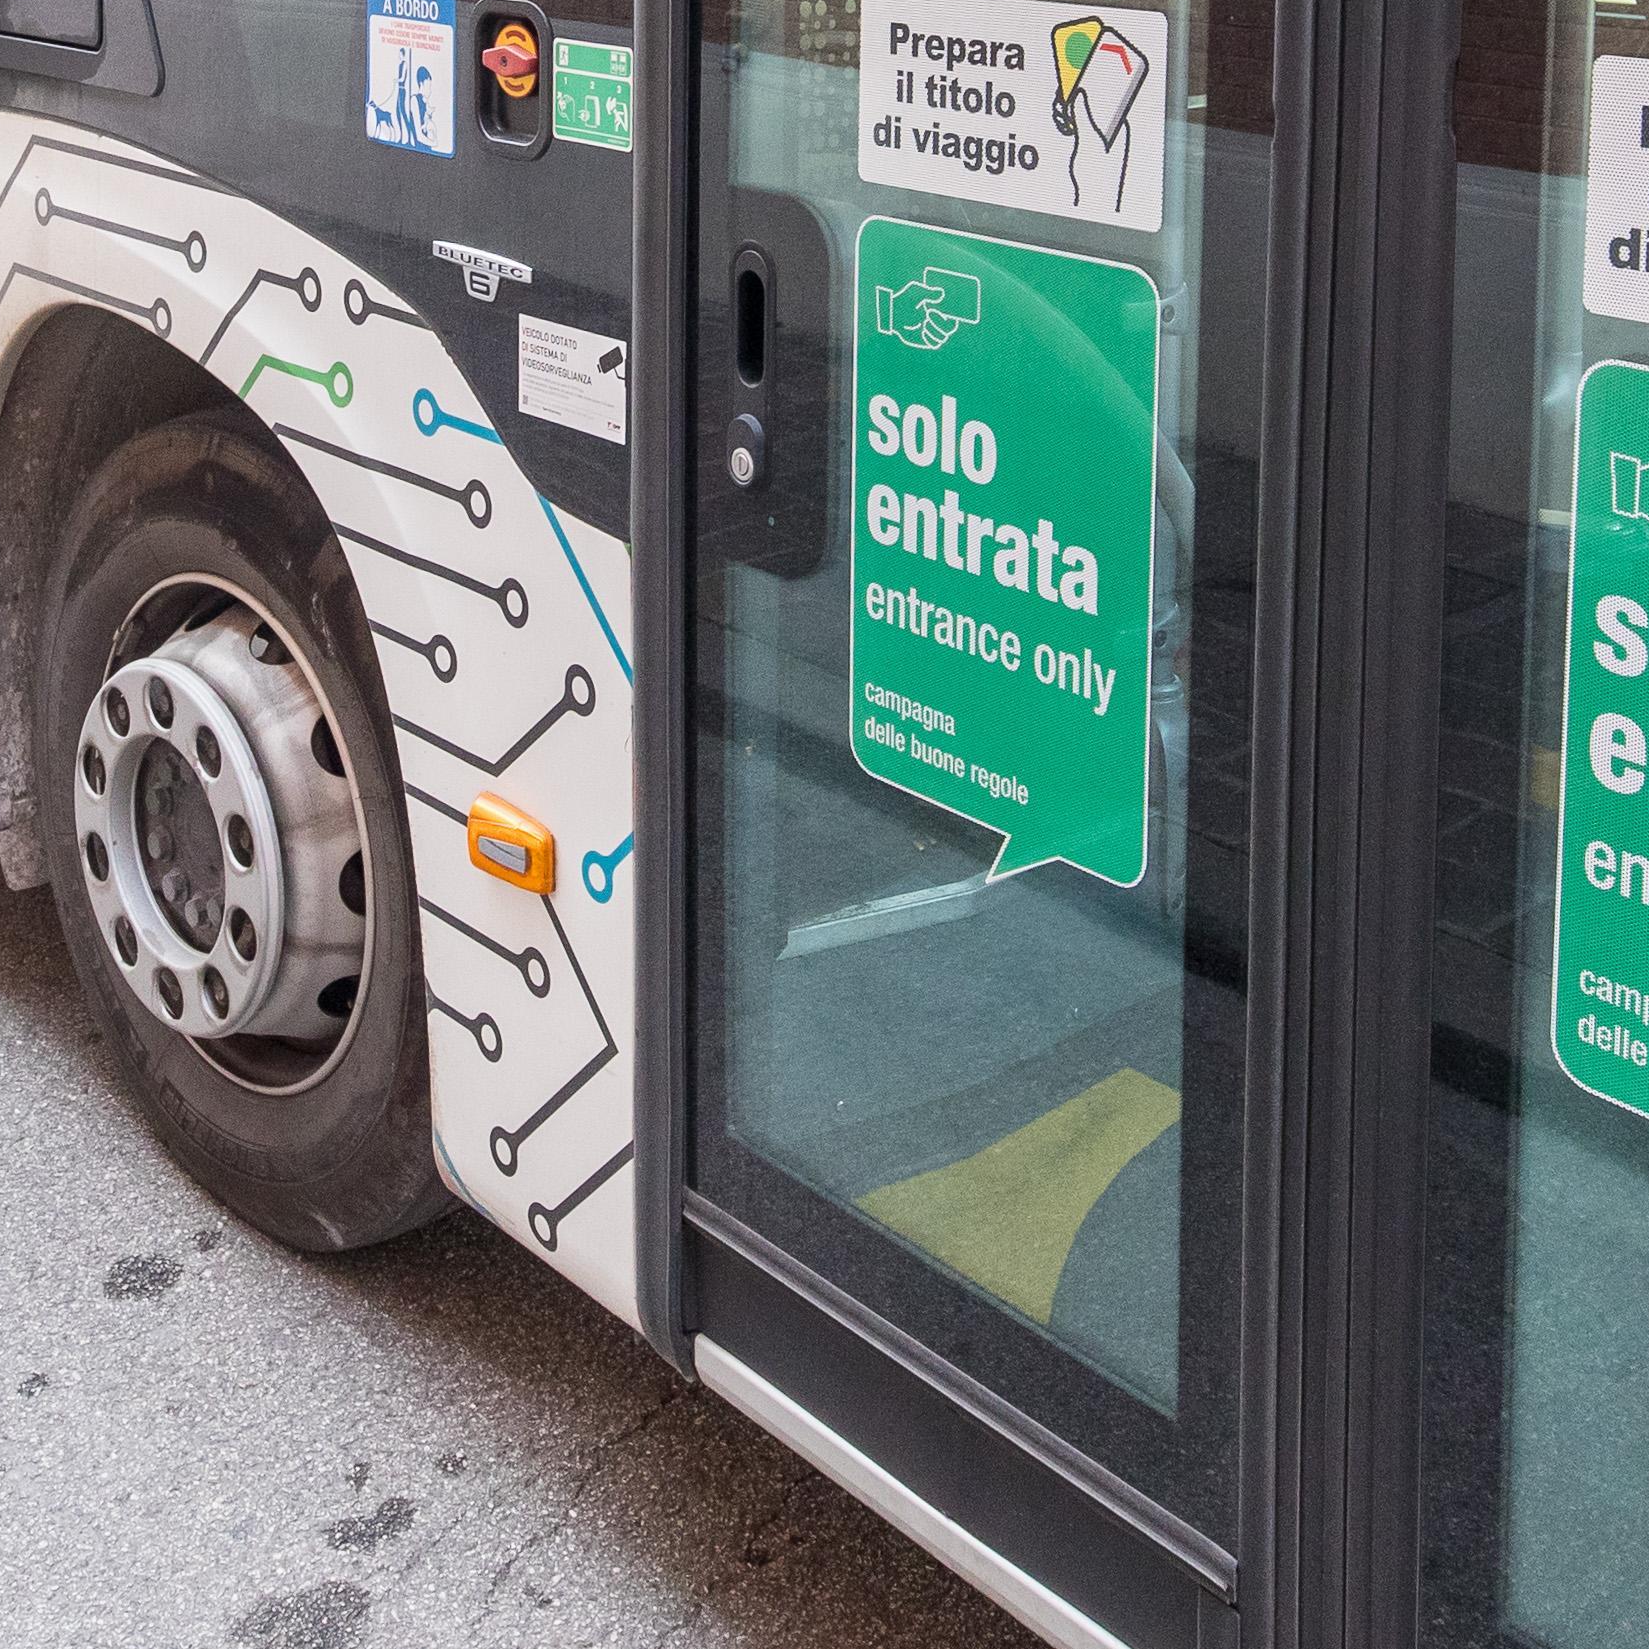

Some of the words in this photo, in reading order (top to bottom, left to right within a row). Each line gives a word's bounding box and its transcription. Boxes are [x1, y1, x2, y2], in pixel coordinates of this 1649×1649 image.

[889, 20, 1026, 73] Prepara
[895, 68, 915, 105] il
[925, 69, 1017, 120] titolo
[872, 115, 904, 151] di
[910, 124, 1040, 175] viaggio
[438, 246, 524, 279] BLUETEC
[469, 271, 490, 296] 6
[521, 326, 549, 342] VEICOLO
[550, 334, 577, 350] DOTATO
[522, 341, 528, 351] DI
[530, 343, 558, 358] SISTEMA
[560, 352, 567, 362] DI
[521, 357, 592, 386] VIDEOSORVEGLIANZA
[867, 392, 998, 488] solo
[867, 479, 1099, 618] entrata
[865, 579, 1022, 673] entrance
[1033, 634, 1115, 717] only
[864, 680, 956, 737] campagna
[864, 712, 905, 752] delle
[909, 730, 966, 778] buone
[969, 755, 1030, 807] regole
